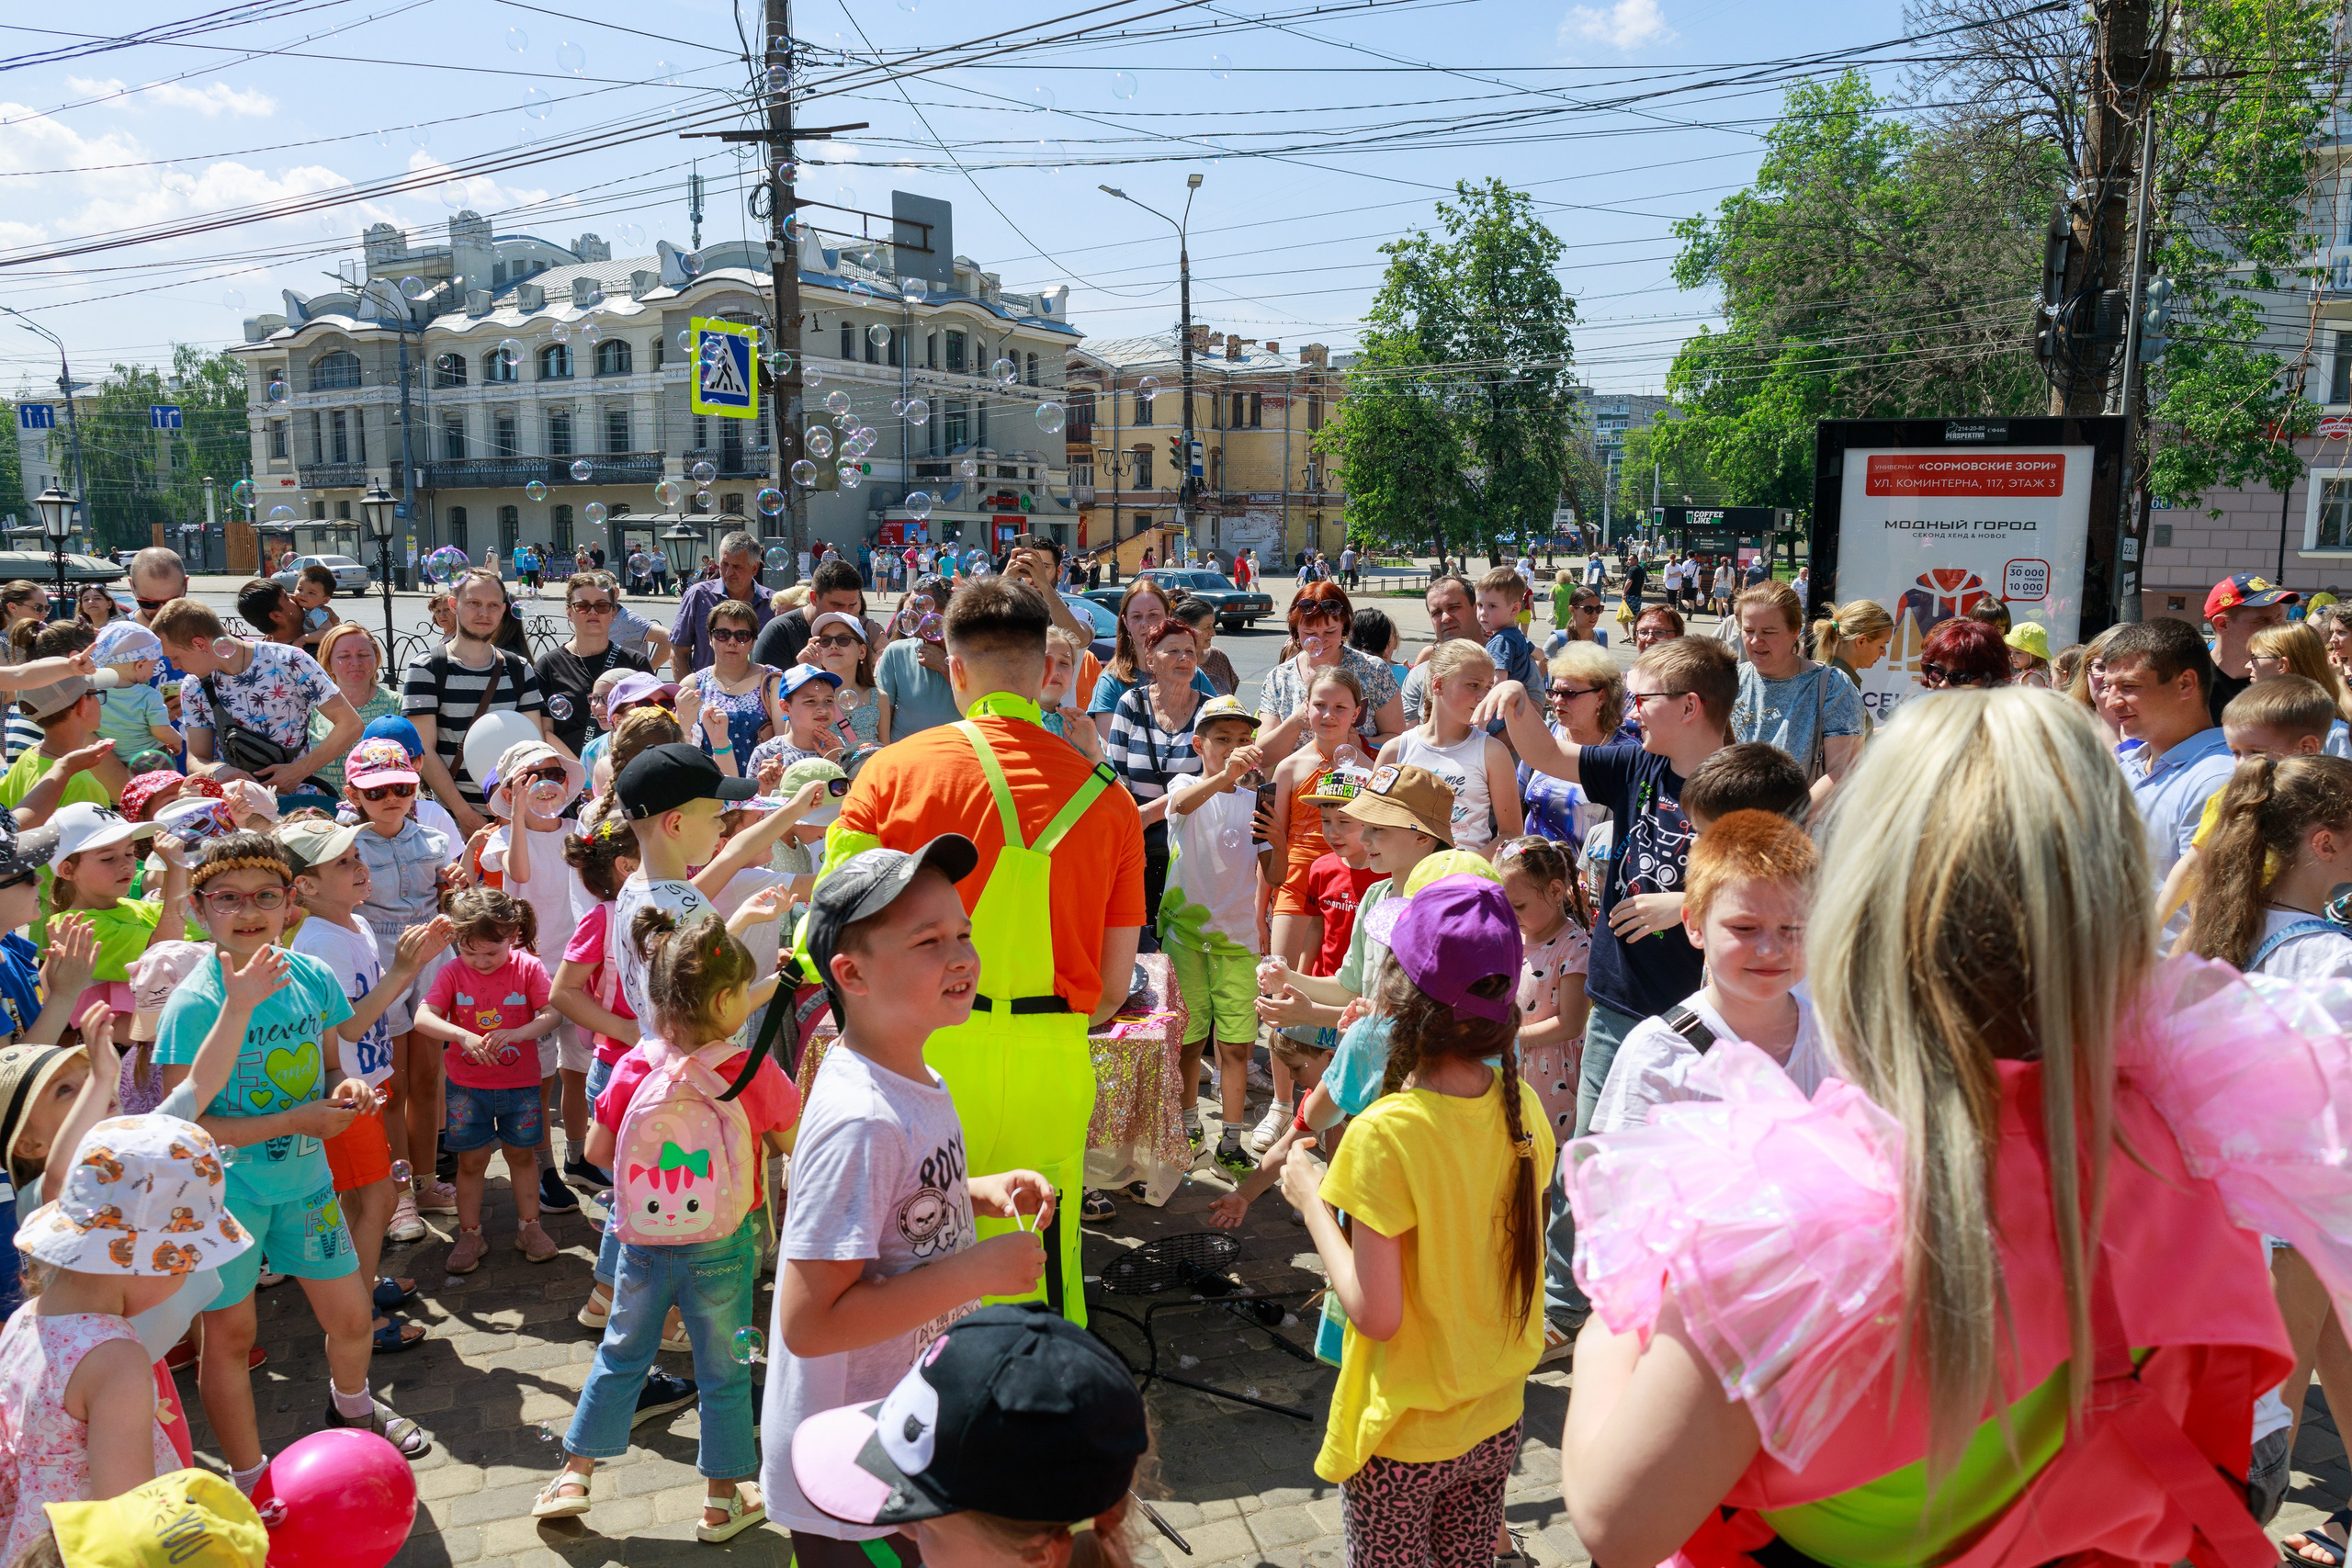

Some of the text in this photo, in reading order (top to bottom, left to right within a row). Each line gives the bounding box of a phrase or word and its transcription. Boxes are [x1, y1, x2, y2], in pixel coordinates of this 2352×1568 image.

[1918, 461, 2013, 471] «СОРМОВСКИЕ
[2015, 461, 2057, 471] ЗОРИ»
[1873, 479, 2056, 490] УЛ. КОМИНТЕРНА, 117, ЭТАЖ 3
[987, 495, 1020, 506] SPAR
[1884, 519, 2037, 531] МОДНЫЙ ГОРОД
[2009, 569, 2045, 577] 30 000
[2009, 582, 2043, 592] 10 000
[248, 1013, 321, 1046] never
[277, 1048, 317, 1082] and
[935, 1312, 949, 1327] YOU
[155, 1508, 214, 1565] YOU
